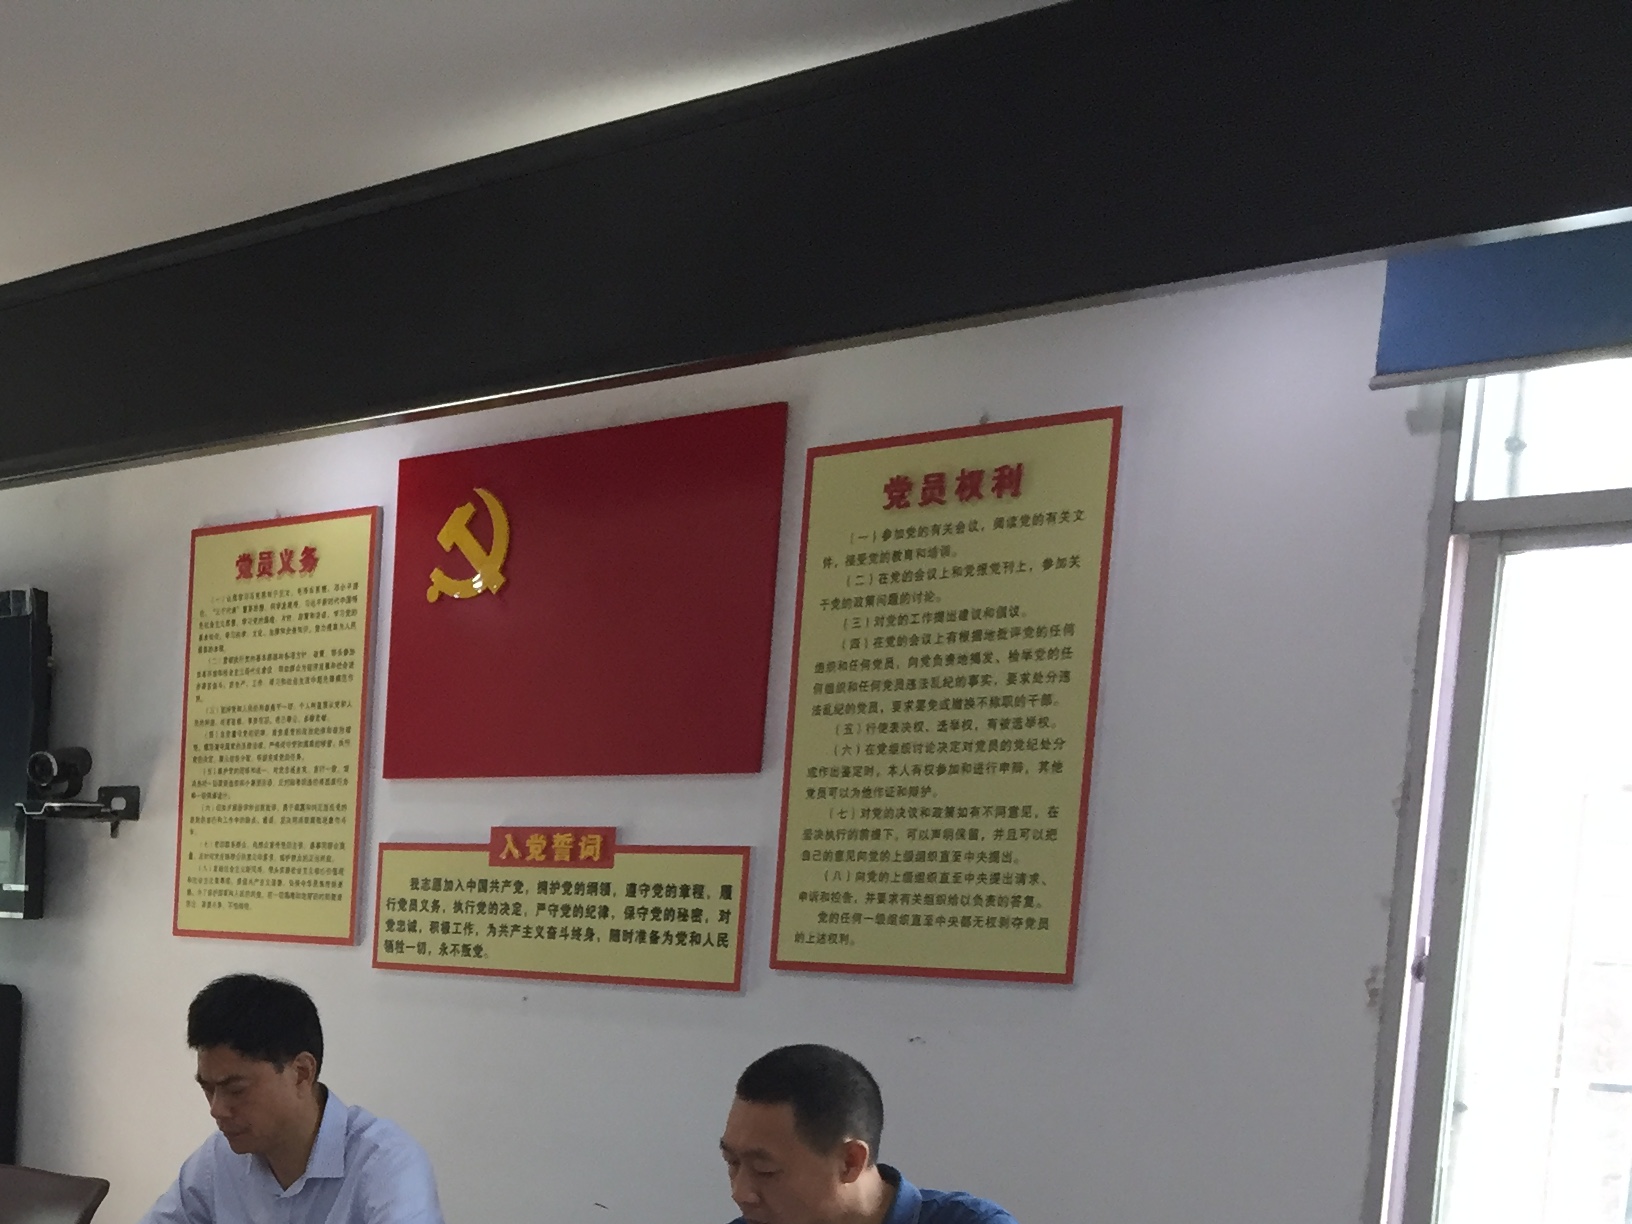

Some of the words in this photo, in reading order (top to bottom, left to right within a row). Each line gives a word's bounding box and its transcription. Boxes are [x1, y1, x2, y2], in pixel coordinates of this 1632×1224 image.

[880, 459, 1025, 512] 党员权利
[234, 544, 319, 580] 党员义务
[499, 833, 604, 862] 入党誓词
